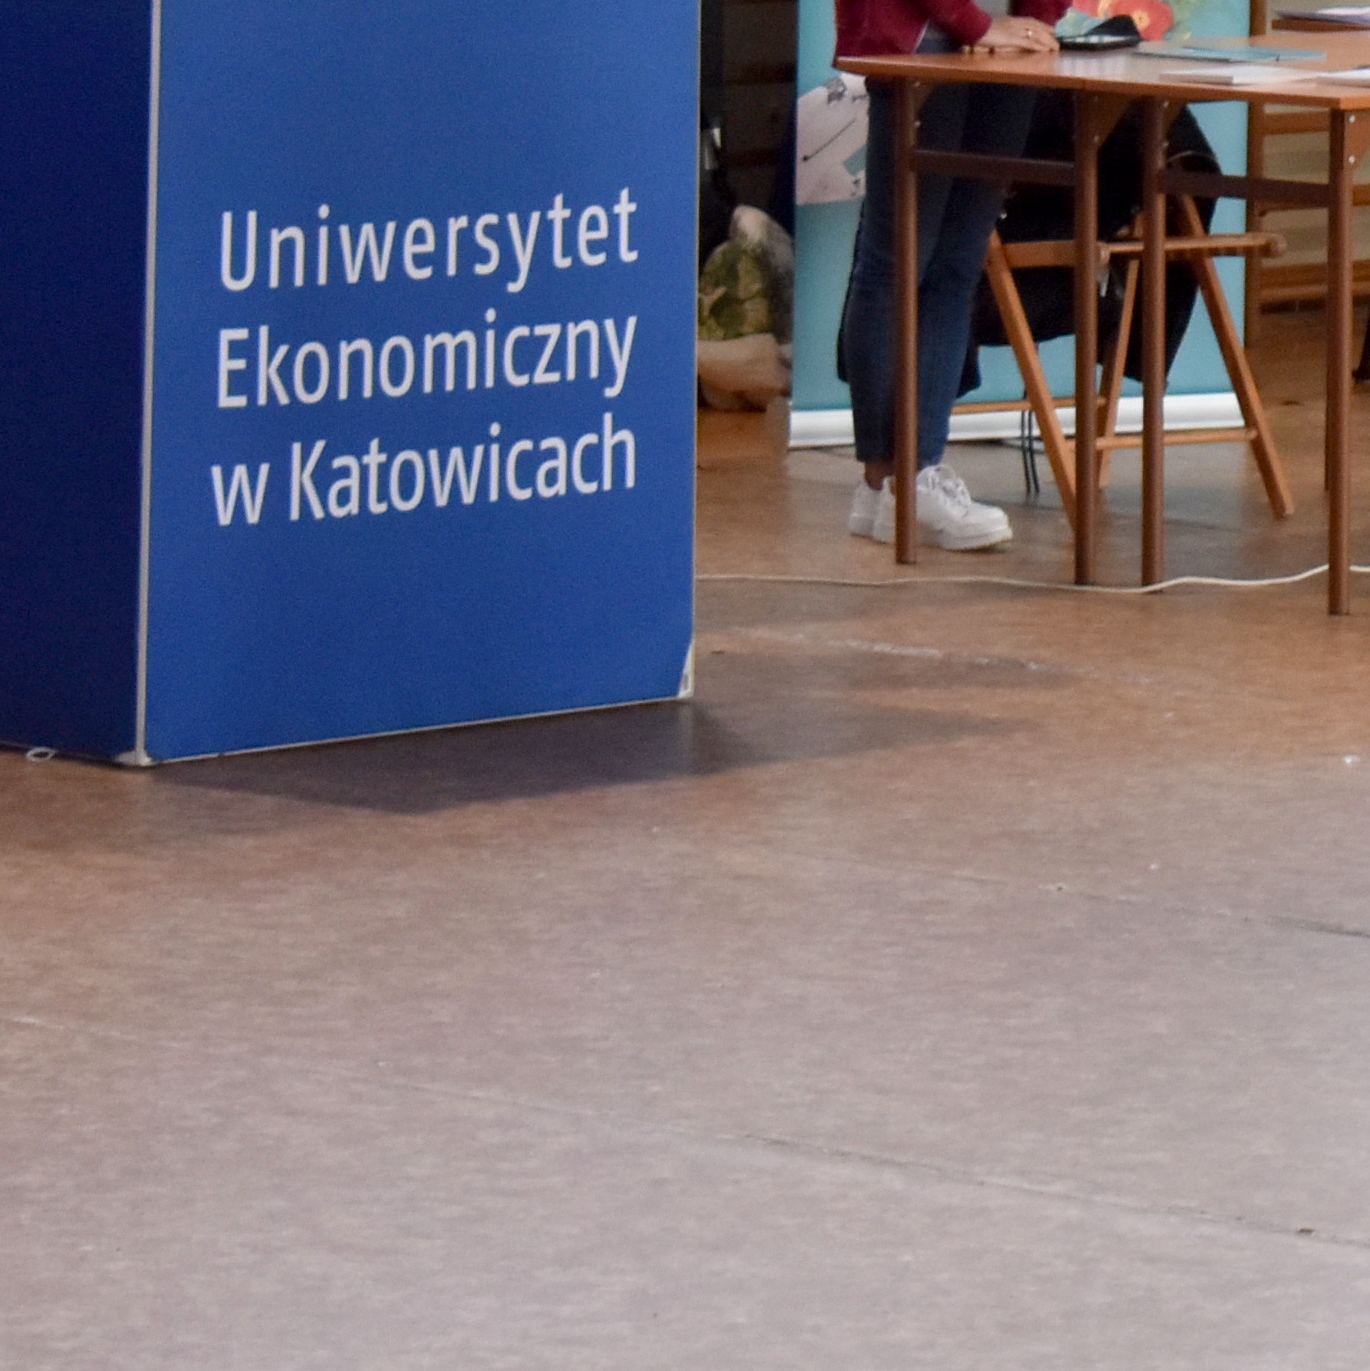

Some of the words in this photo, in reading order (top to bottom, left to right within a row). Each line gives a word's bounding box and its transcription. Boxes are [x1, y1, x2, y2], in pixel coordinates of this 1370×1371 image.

[218, 186, 640, 293] Uniwersytet
[216, 307, 638, 409] Ekonomiczny
[210, 458, 271, 528] w
[288, 412, 637, 523] Katowicach
